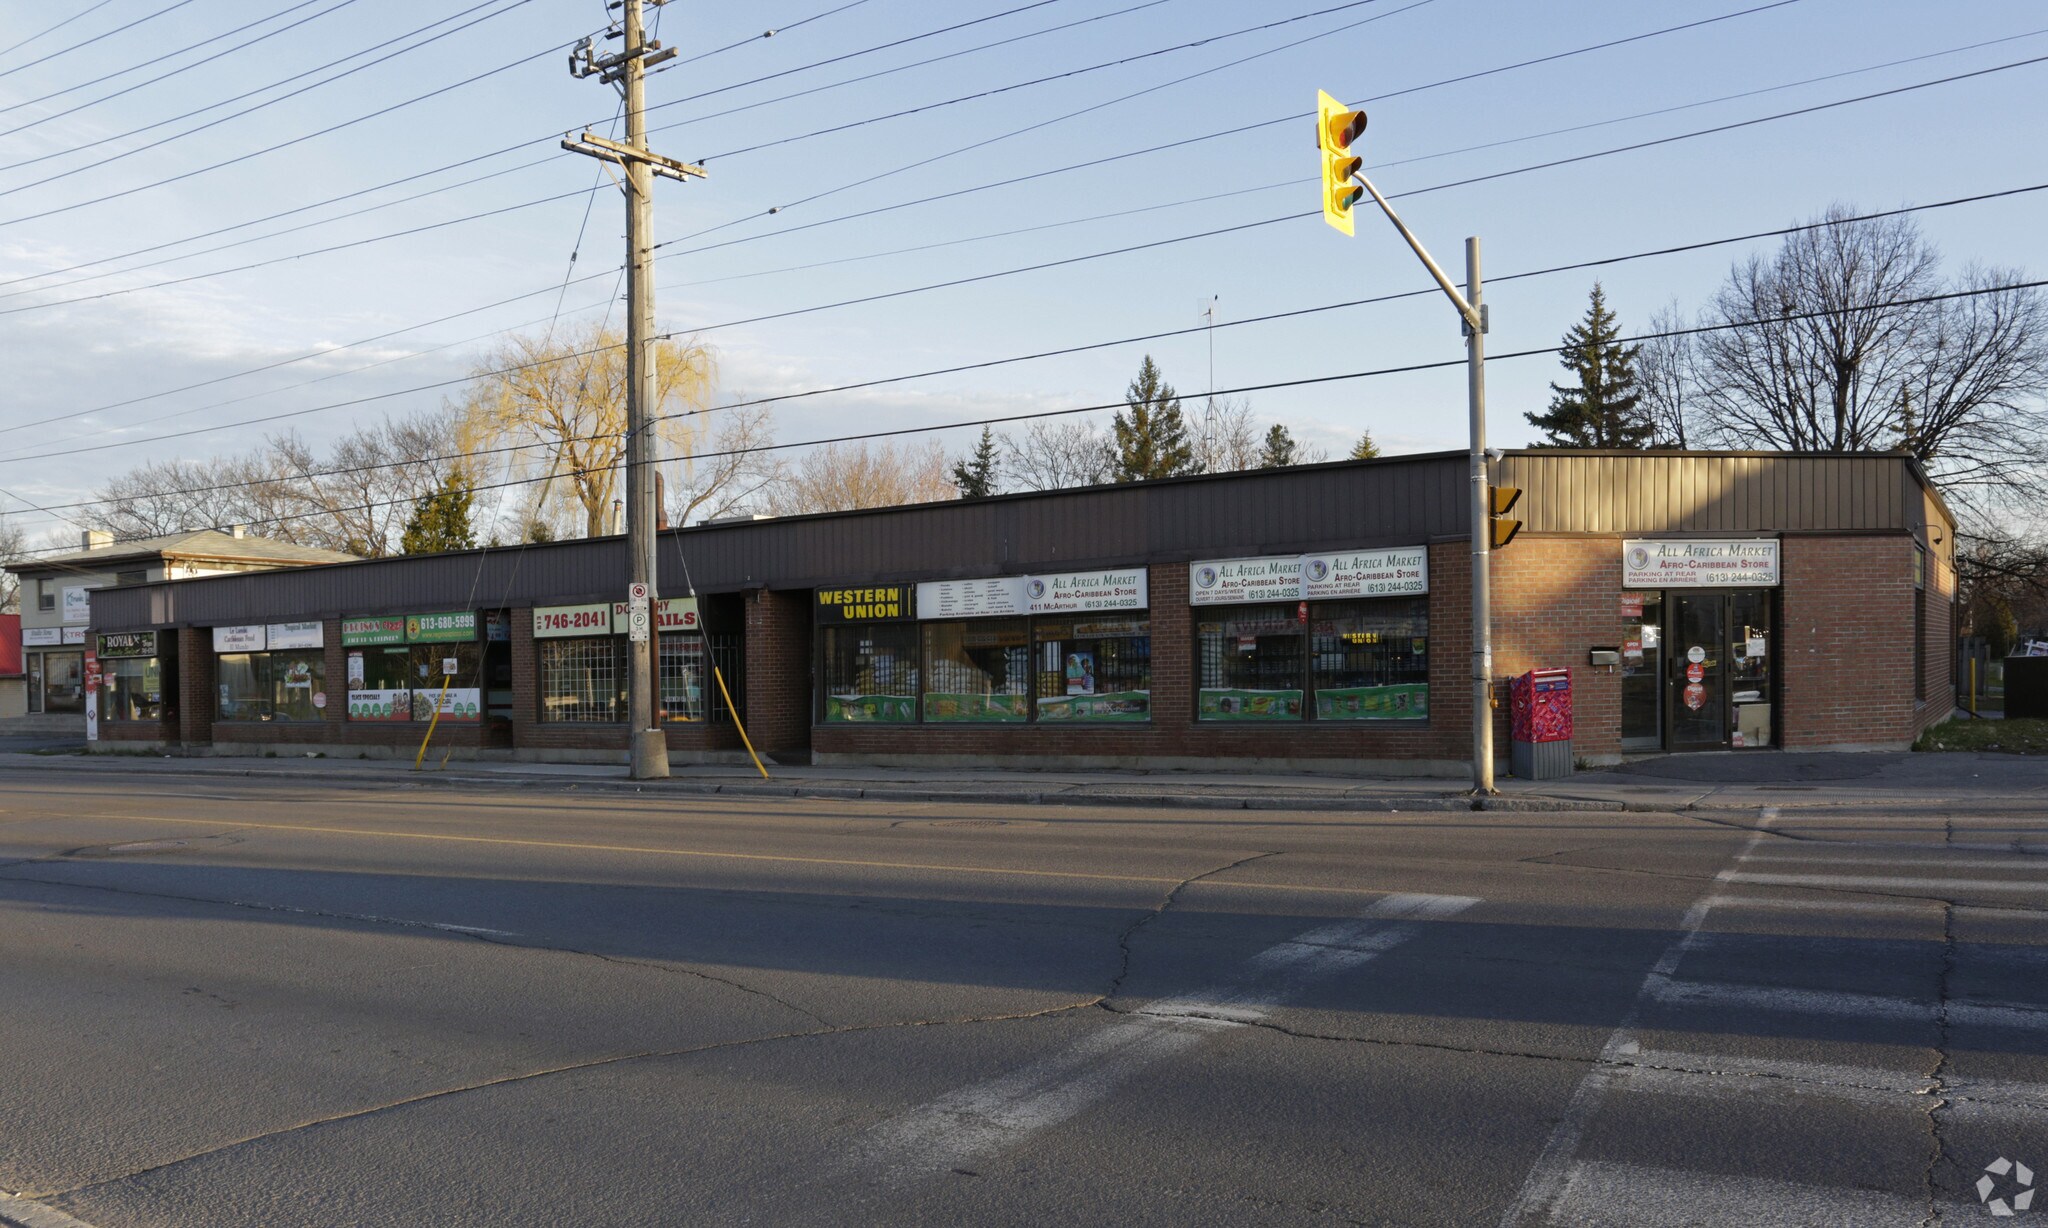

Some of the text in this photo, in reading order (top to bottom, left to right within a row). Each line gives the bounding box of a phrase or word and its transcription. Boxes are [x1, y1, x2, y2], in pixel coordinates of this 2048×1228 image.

[1657, 544, 1773, 557] ALL AFRICA MARKET
[1332, 555, 1422, 571] ALL AFRICA MARKET
[1660, 559, 1769, 569] AFRO-CARIBBEAN STORE
[1219, 562, 1302, 578] ALL AFRICA MARKET
[1334, 569, 1420, 582] AFRO-CARIBBEAN STORE
[1052, 574, 1137, 589] ALL AFRICA MARKET
[1221, 576, 1300, 588] AFRO-CARIBBEAN STORE
[1706, 572, 1774, 583] (613) 244-0325
[1054, 587, 1137, 599] AFRO-CARIBBEAN STORE
[1248, 588, 1300, 599] (613) 244-0325
[1367, 581, 1423, 593] (613) 244-0325
[819, 587, 899, 605] WESTERN
[1104, 599, 1138, 607] 244-0325
[843, 603, 899, 619] UNION
[421, 615, 475, 630] 613-680-5999
[544, 611, 606, 629] 746-2041
[107, 635, 133, 647] ROYAL
